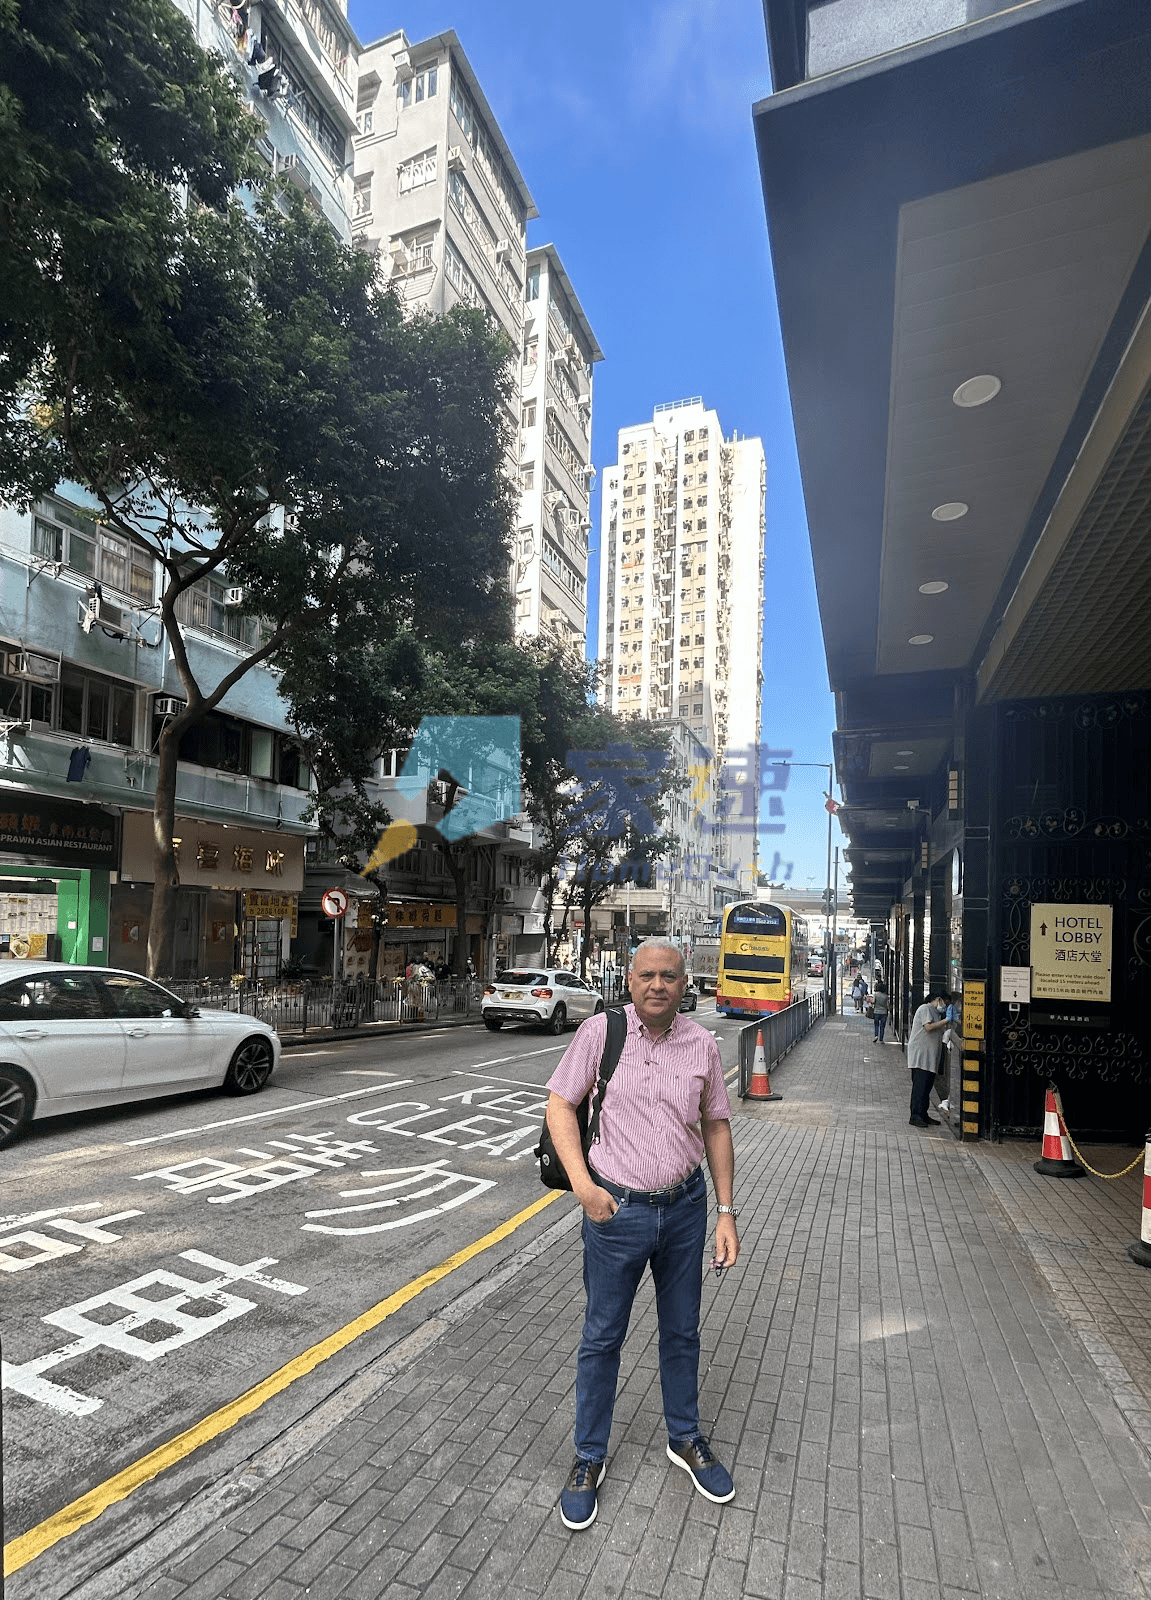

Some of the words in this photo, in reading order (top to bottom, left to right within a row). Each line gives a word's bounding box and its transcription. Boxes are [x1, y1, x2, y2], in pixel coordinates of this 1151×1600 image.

[0, 834, 35, 845] PRAWN
[36, 838, 63, 847] ASIAN
[64, 841, 113, 852] RESTAURANT
[1055, 917, 1104, 929] HOTEL
[1055, 932, 1103, 944] LOBBY
[1055, 949, 1102, 962] 酒店大堂
[966, 1013, 983, 1022] 小心
[438, 1085, 550, 1118] KEE
[130, 1131, 499, 1237] 請勿
